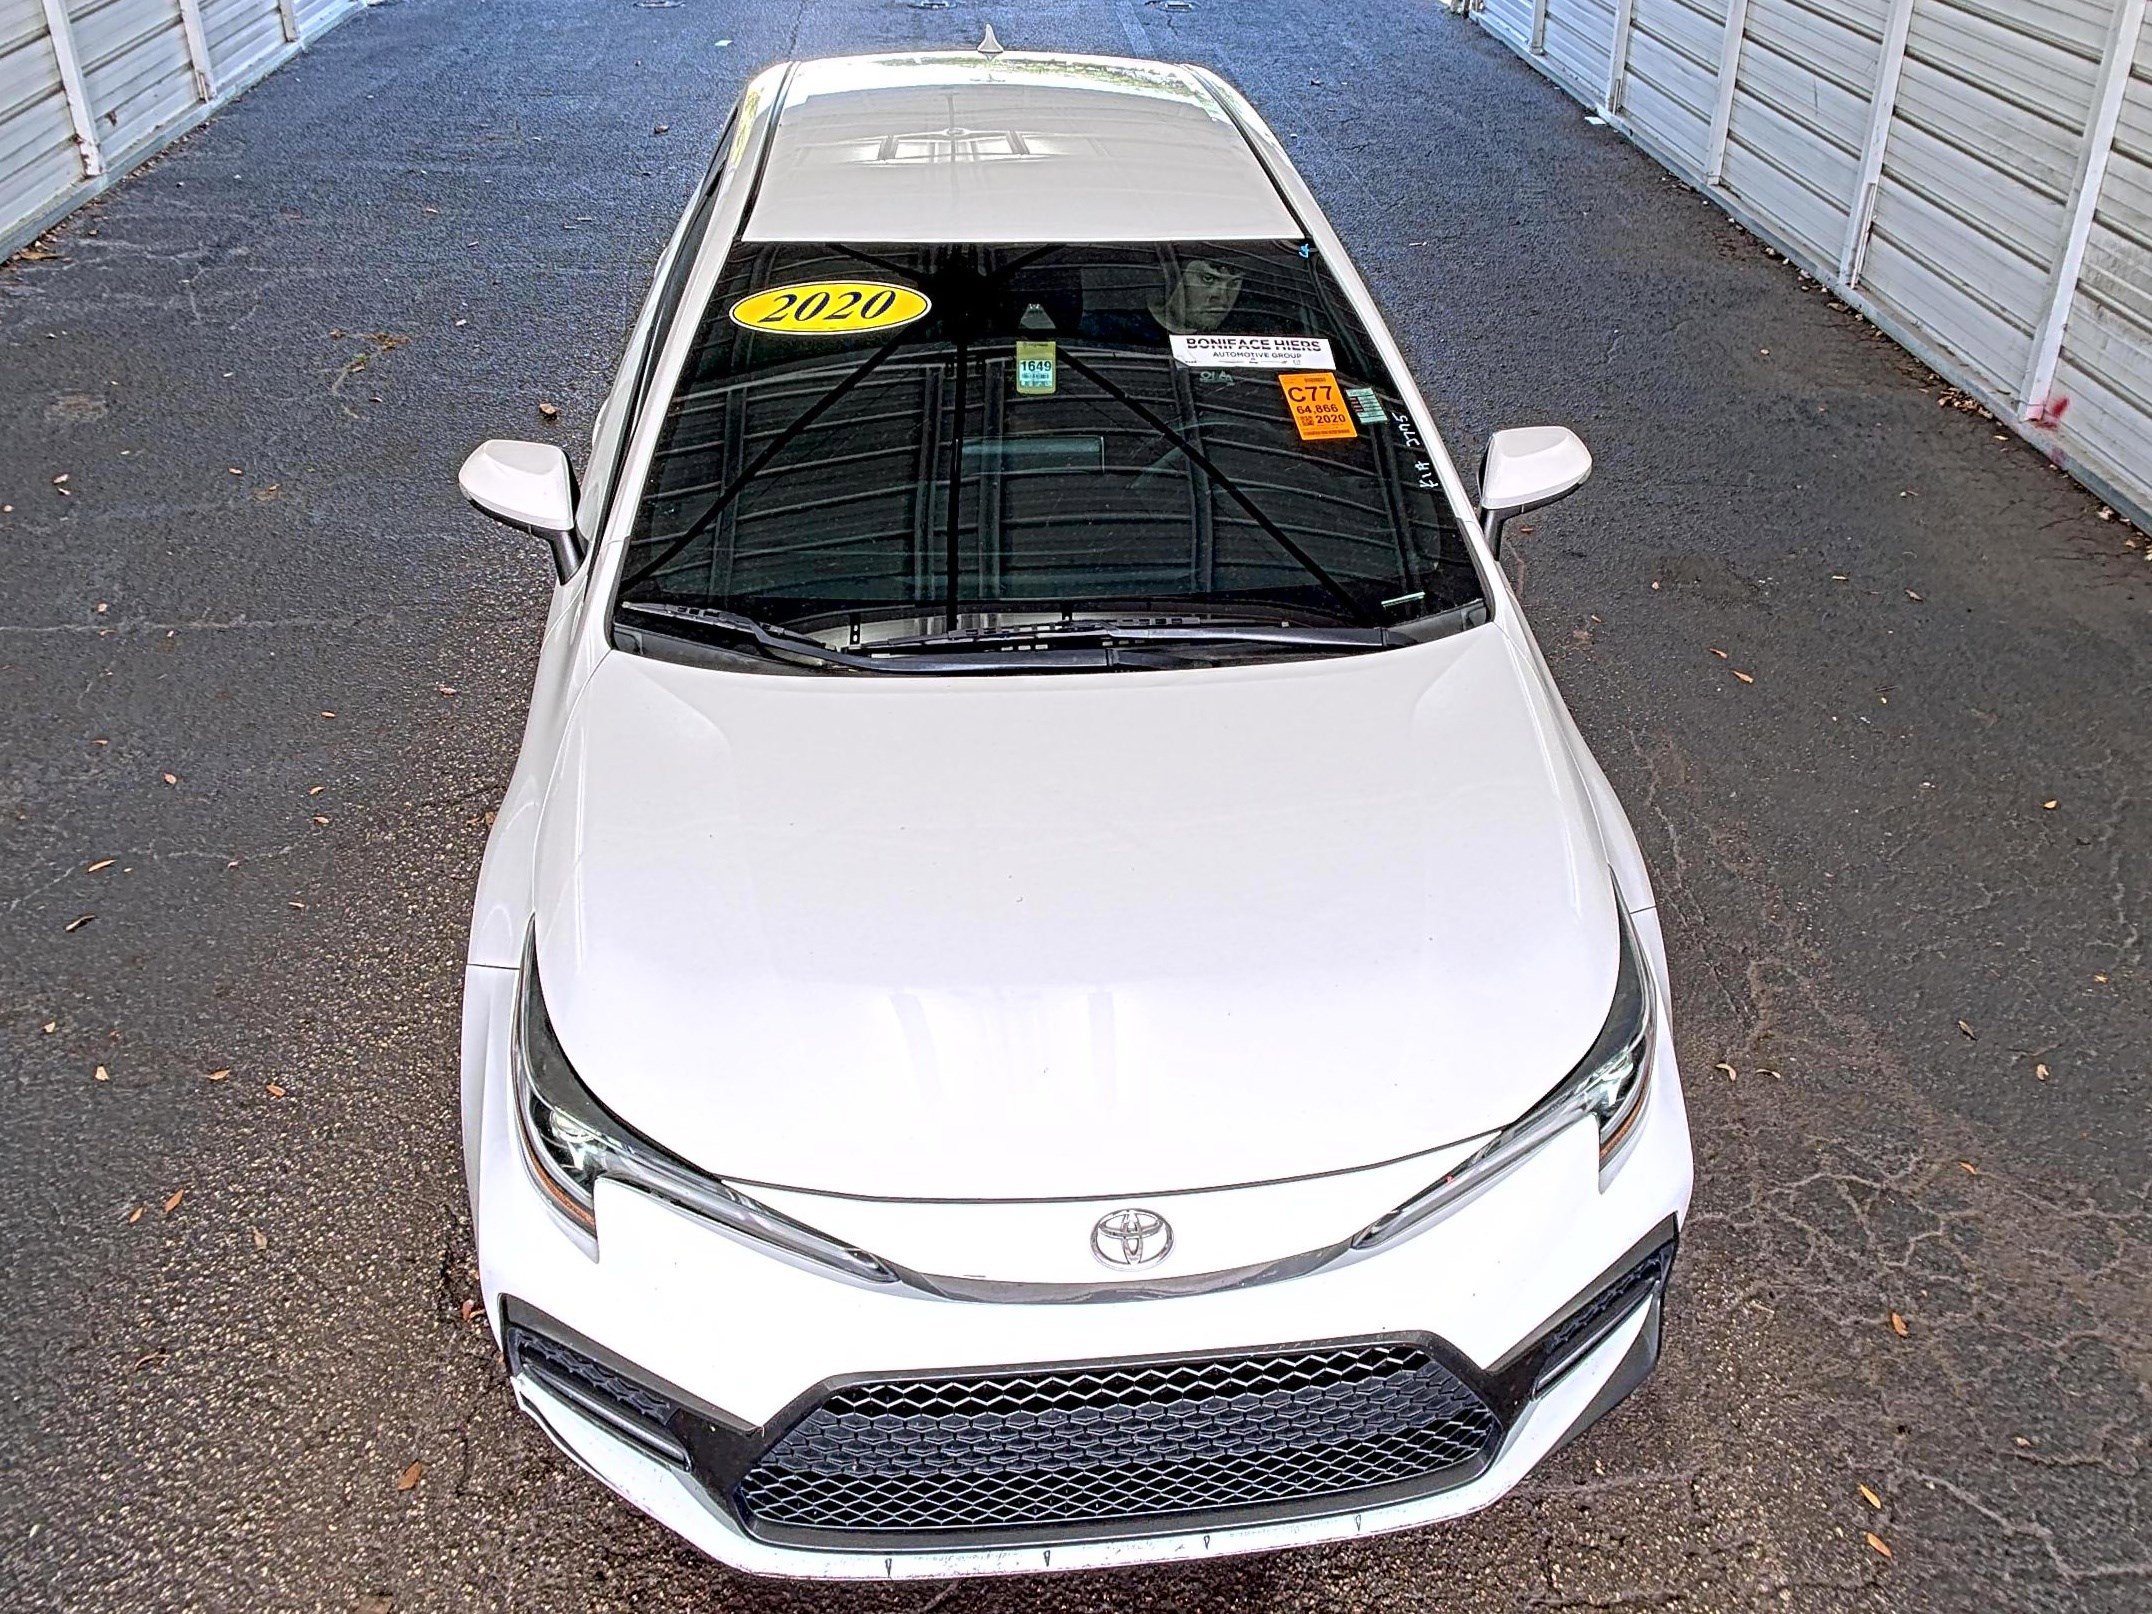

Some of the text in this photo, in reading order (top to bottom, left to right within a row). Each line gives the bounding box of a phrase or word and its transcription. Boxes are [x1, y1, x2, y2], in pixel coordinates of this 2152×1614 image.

[757, 290, 896, 323] 2020
[1186, 338, 1322, 352] BONIFACE HIERS
[1020, 360, 1052, 371] 1649
[1288, 385, 1332, 403] C77
[1296, 404, 1339, 415] 64,866
[1315, 414, 1346, 424] 2020
